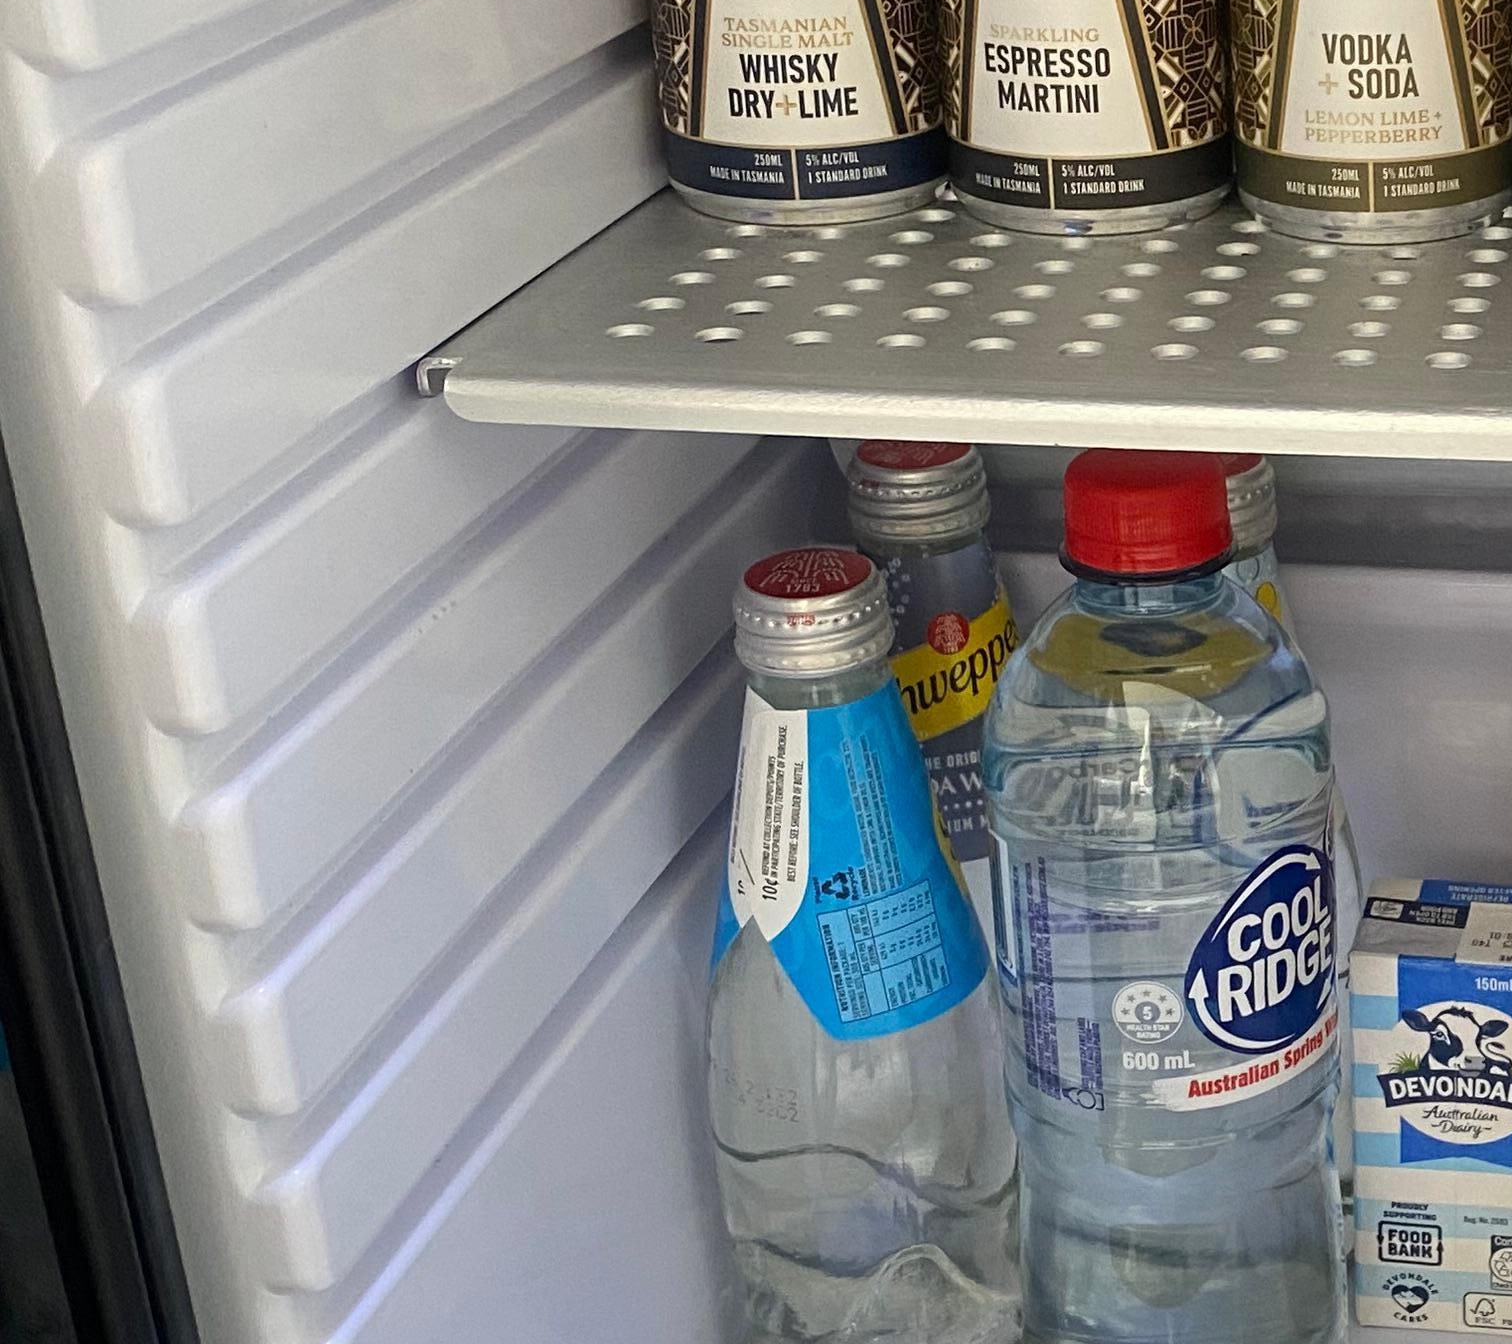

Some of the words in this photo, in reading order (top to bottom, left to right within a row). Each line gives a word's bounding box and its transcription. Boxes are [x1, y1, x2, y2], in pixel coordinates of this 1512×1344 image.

[723, 17, 847, 33] TASMANIAN
[989, 23, 1099, 42] SPARKLING
[722, 33, 793, 48] SINGLE
[798, 32, 854, 48] MALT
[1321, 33, 1413, 65] VODKA
[739, 53, 838, 83] WHISKY
[984, 42, 1111, 78] ESPRESSO
[1318, 73, 1339, 95] +
[1348, 67, 1419, 100] SODA
[997, 80, 1099, 113] MARTINI
[1305, 109, 1374, 126] LEMON
[1381, 109, 1430, 125] LIME
[1305, 126, 1442, 144] PEPPERBERRY
[754, 154, 783, 166] 250ML
[805, 154, 820, 166] 5%
[821, 152, 859, 165] ALC/VOL
[710, 166, 730, 180] MADE
[731, 168, 740, 181] IN
[741, 170, 785, 184] TASMANIA
[815, 168, 861, 183] STANDARD
[862, 165, 888, 179] DRINK
[1013, 163, 1040, 176] 250ML
[1061, 164, 1075, 177] 5%
[1077, 164, 1115, 177] ALC/VOL
[1331, 168, 1360, 181] 250ML
[1382, 167, 1396, 180] 5%
[1398, 165, 1434, 179] ALC/VOL
[1063, 183, 1068, 194] 1
[1070, 181, 1116, 195] STANDARD
[1118, 179, 1145, 192] DRINK
[1286, 181, 1306, 195] MADE
[1307, 183, 1317, 196] IN
[1317, 183, 1361, 199] TASMANIA
[1391, 183, 1435, 197] STANDARD
[1436, 179, 1460, 193] DRINK
[895, 616, 1020, 715] hweppe
[790, 828, 799, 840] SEE
[846, 865, 861, 901] Recycle
[1227, 875, 1330, 963] COOL
[1217, 915, 1332, 1023] RIDGE
[1142, 1006, 1152, 1021] 5
[1123, 1051, 1159, 1070] 600
[1164, 1050, 1195, 1070] mL
[1188, 1057, 1280, 1098] Australian
[1284, 1031, 1323, 1069] Spring
[1423, 1105, 1499, 1122] Australian
[1439, 1120, 1482, 1138] Dairy
[1384, 1211, 1437, 1221] SUPPORTING
[1388, 1229, 1432, 1244] FOOD
[1388, 1243, 1432, 1258] BANK
[1382, 1272, 1439, 1295] DEVONDALE
[1394, 1312, 1428, 1323] CARES
